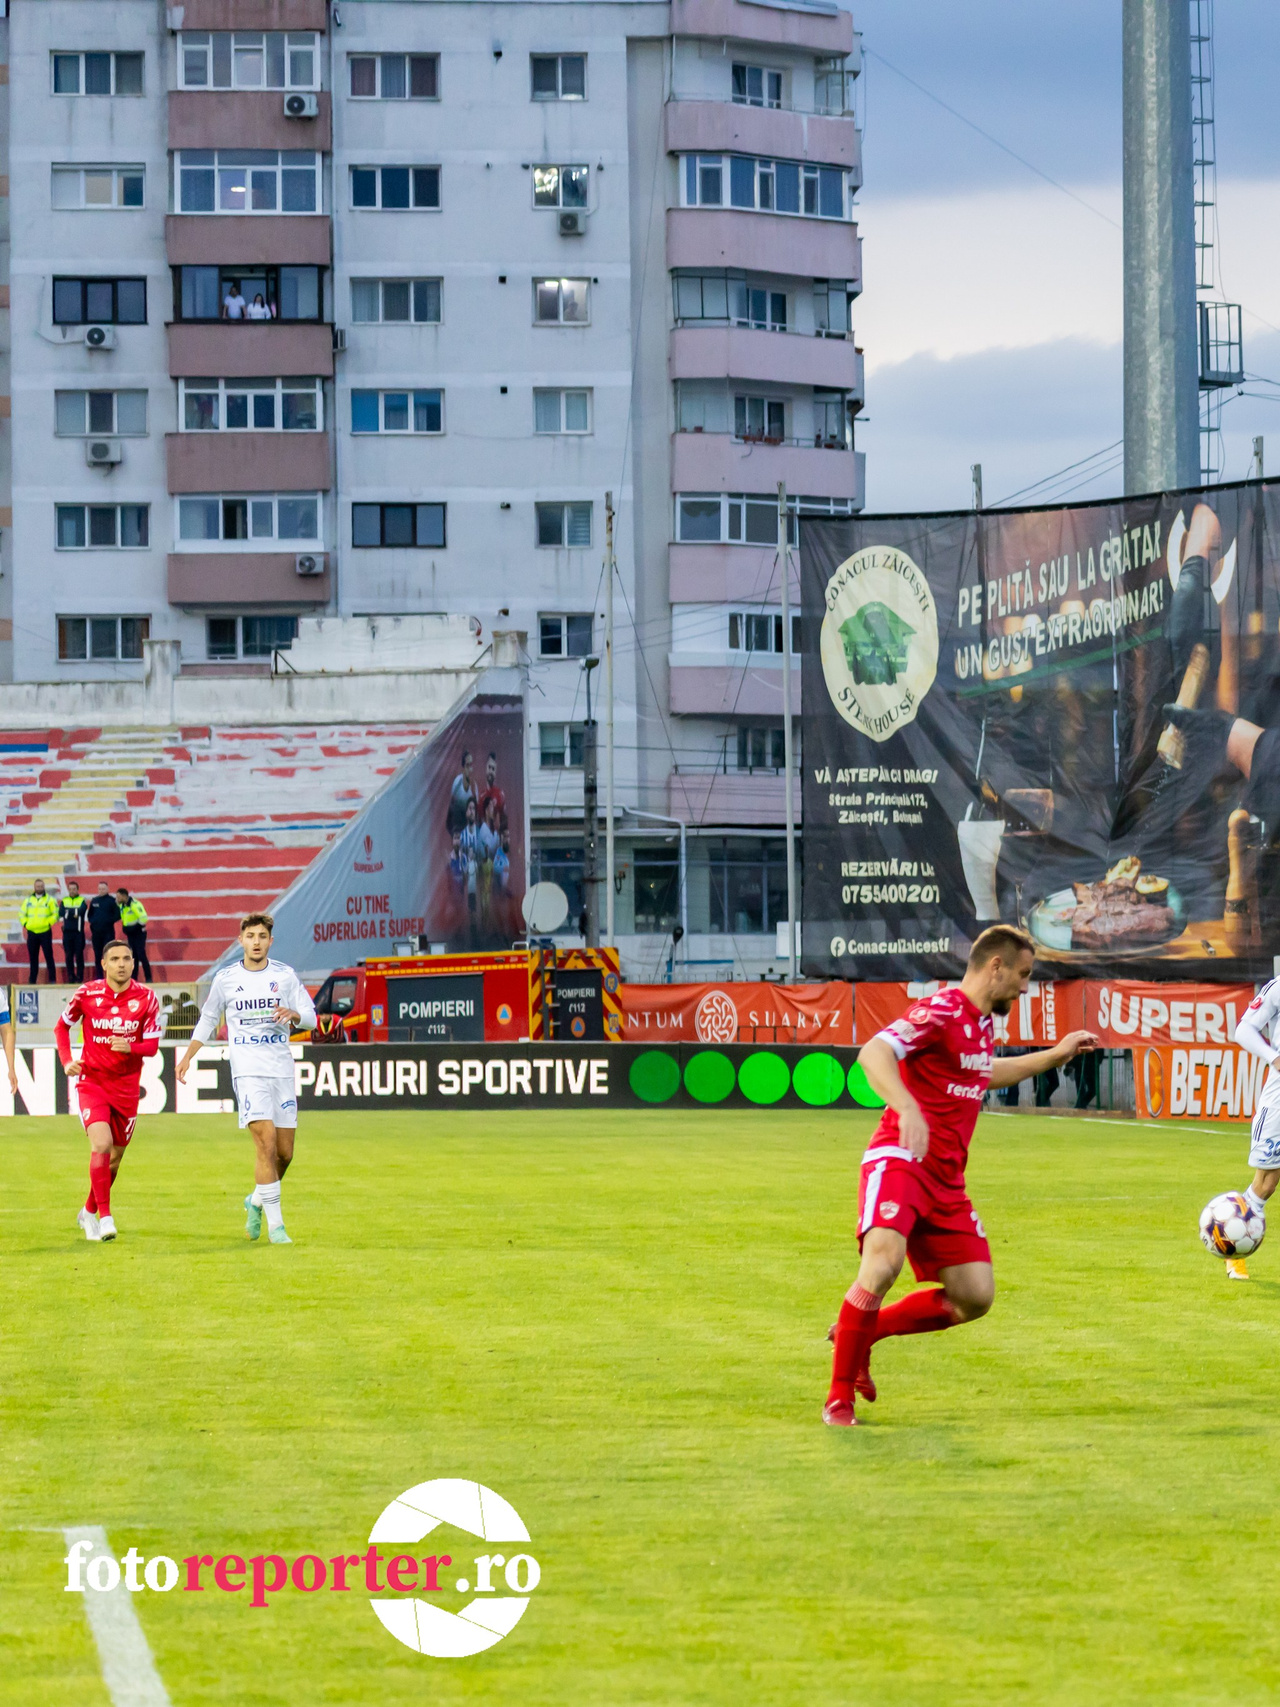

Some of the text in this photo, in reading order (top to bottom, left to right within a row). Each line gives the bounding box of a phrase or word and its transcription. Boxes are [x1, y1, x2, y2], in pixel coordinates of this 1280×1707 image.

[828, 554, 878, 612] CONACUL
[958, 584, 982, 628] PE
[988, 559, 1034, 620] PLITĂ
[1038, 555, 1068, 603] SAU
[1077, 548, 1096, 591] LA
[957, 578, 1164, 680] UN GUST EXTRAORDINAR!
[814, 766, 832, 784] VĂ
[904, 769, 939, 784] DRAG!
[841, 858, 918, 876] REZERVĂRI
[346, 894, 392, 918] CU TINE,
[314, 917, 425, 943] SUPERLIGA E SUPER
[557, 988, 596, 999] POMPIERII
[235, 997, 281, 1011] UNIBET
[399, 1000, 474, 1019] POMPIERII
[749, 1010, 840, 1028] SUARAZ
[432, 1024, 446, 1034] 112
[234, 1033, 287, 1045] ELSACO
[295, 1058, 609, 1098] PARIURI SPORTIVE
[244, 1094, 251, 1112] 6
